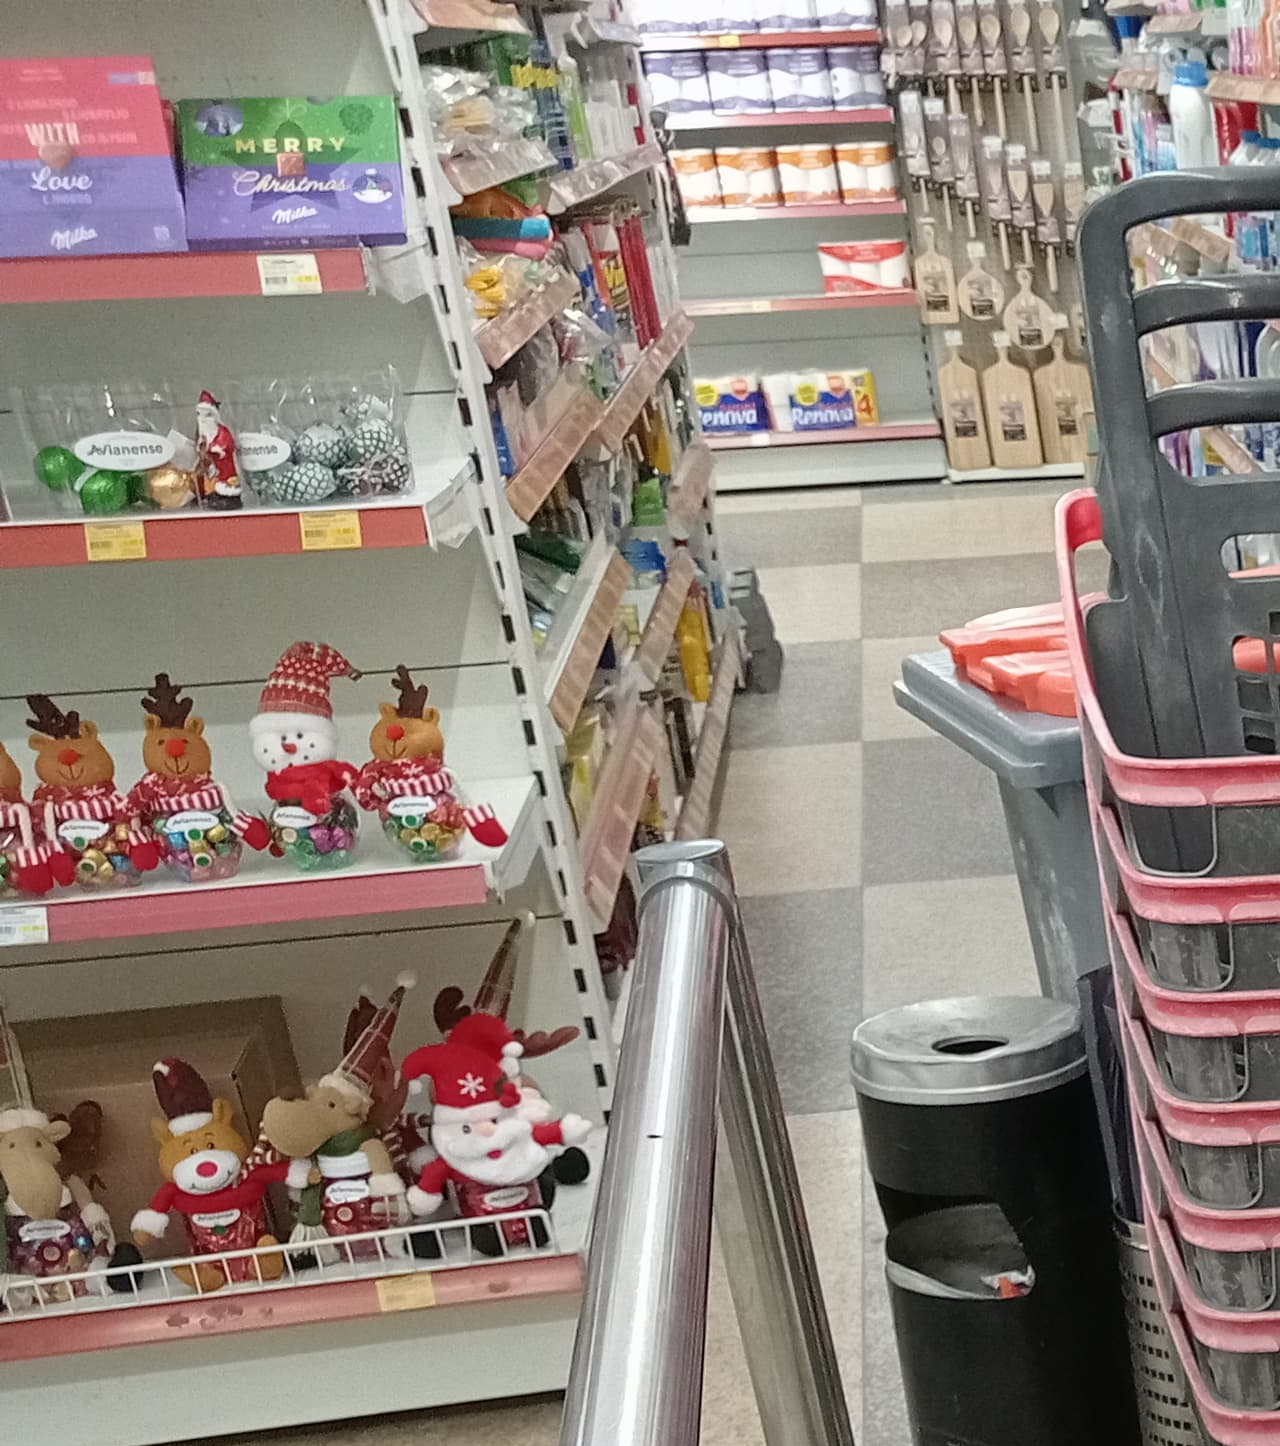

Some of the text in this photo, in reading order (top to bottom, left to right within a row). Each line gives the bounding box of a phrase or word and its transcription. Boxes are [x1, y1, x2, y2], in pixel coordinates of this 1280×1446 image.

[25, 122, 80, 147] WITH
[234, 136, 346, 154] MERRY
[31, 166, 93, 191] Love
[231, 171, 352, 196] Christmas
[271, 205, 319, 225] Milka
[50, 226, 98, 250] Milka
[698, 408, 757, 426] enova
[791, 406, 854, 425] Renova
